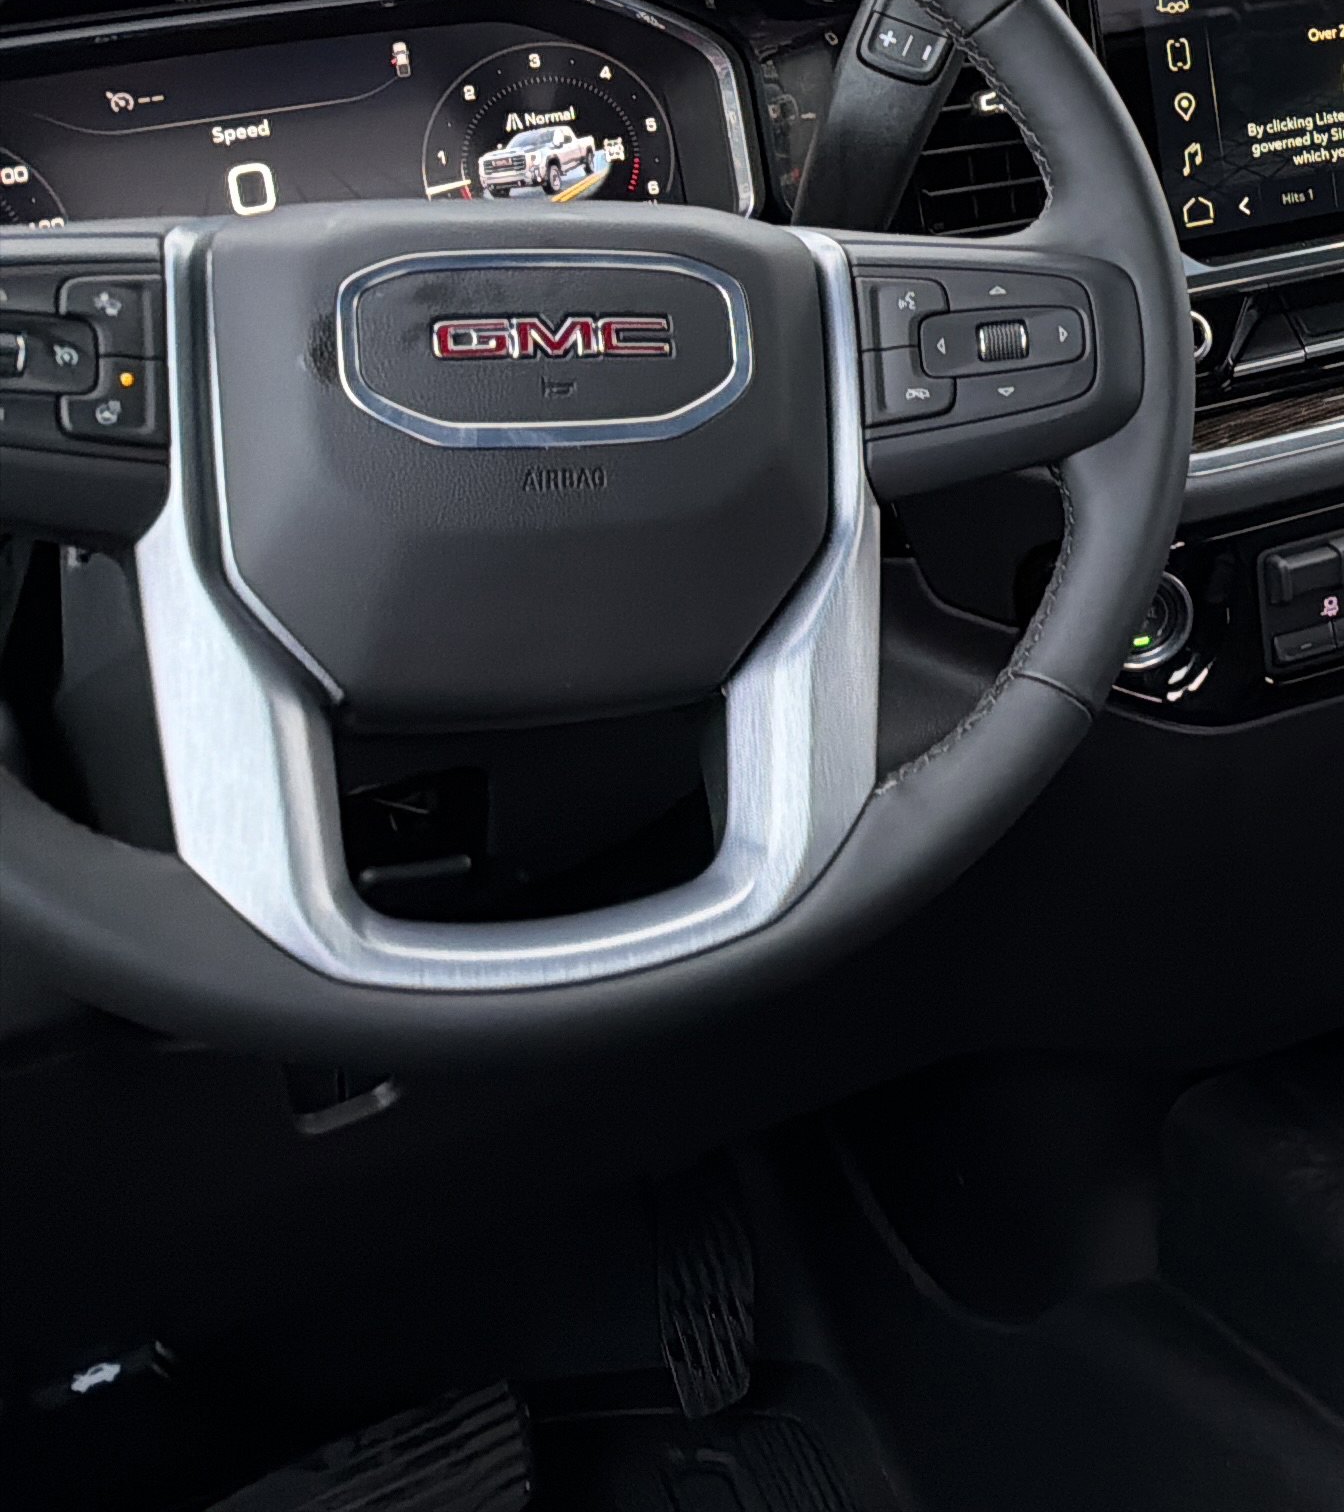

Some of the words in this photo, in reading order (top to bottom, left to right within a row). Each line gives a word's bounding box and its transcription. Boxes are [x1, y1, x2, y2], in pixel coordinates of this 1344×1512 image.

[1308, 27, 1337, 43] Over
[529, 53, 541, 69] 3
[599, 65, 612, 80] 4
[463, 85, 477, 101] 2
[524, 106, 576, 128] Normal
[645, 117, 657, 132] 5
[211, 119, 271, 146] Speed
[1247, 122, 1264, 139] By
[1266, 115, 1314, 135] clicking
[1251, 133, 1311, 158] governed
[1313, 131, 1329, 147] by
[437, 149, 448, 167] 1
[1292, 147, 1331, 166] which
[0, 165, 29, 185] 00
[227, 162, 277, 216] 0
[647, 180, 660, 196] 6
[1281, 190, 1306, 206] Hits
[1307, 188, 1315, 202] 1
[432, 316, 672, 359] GMC
[523, 467, 608, 492] AIRBAG
